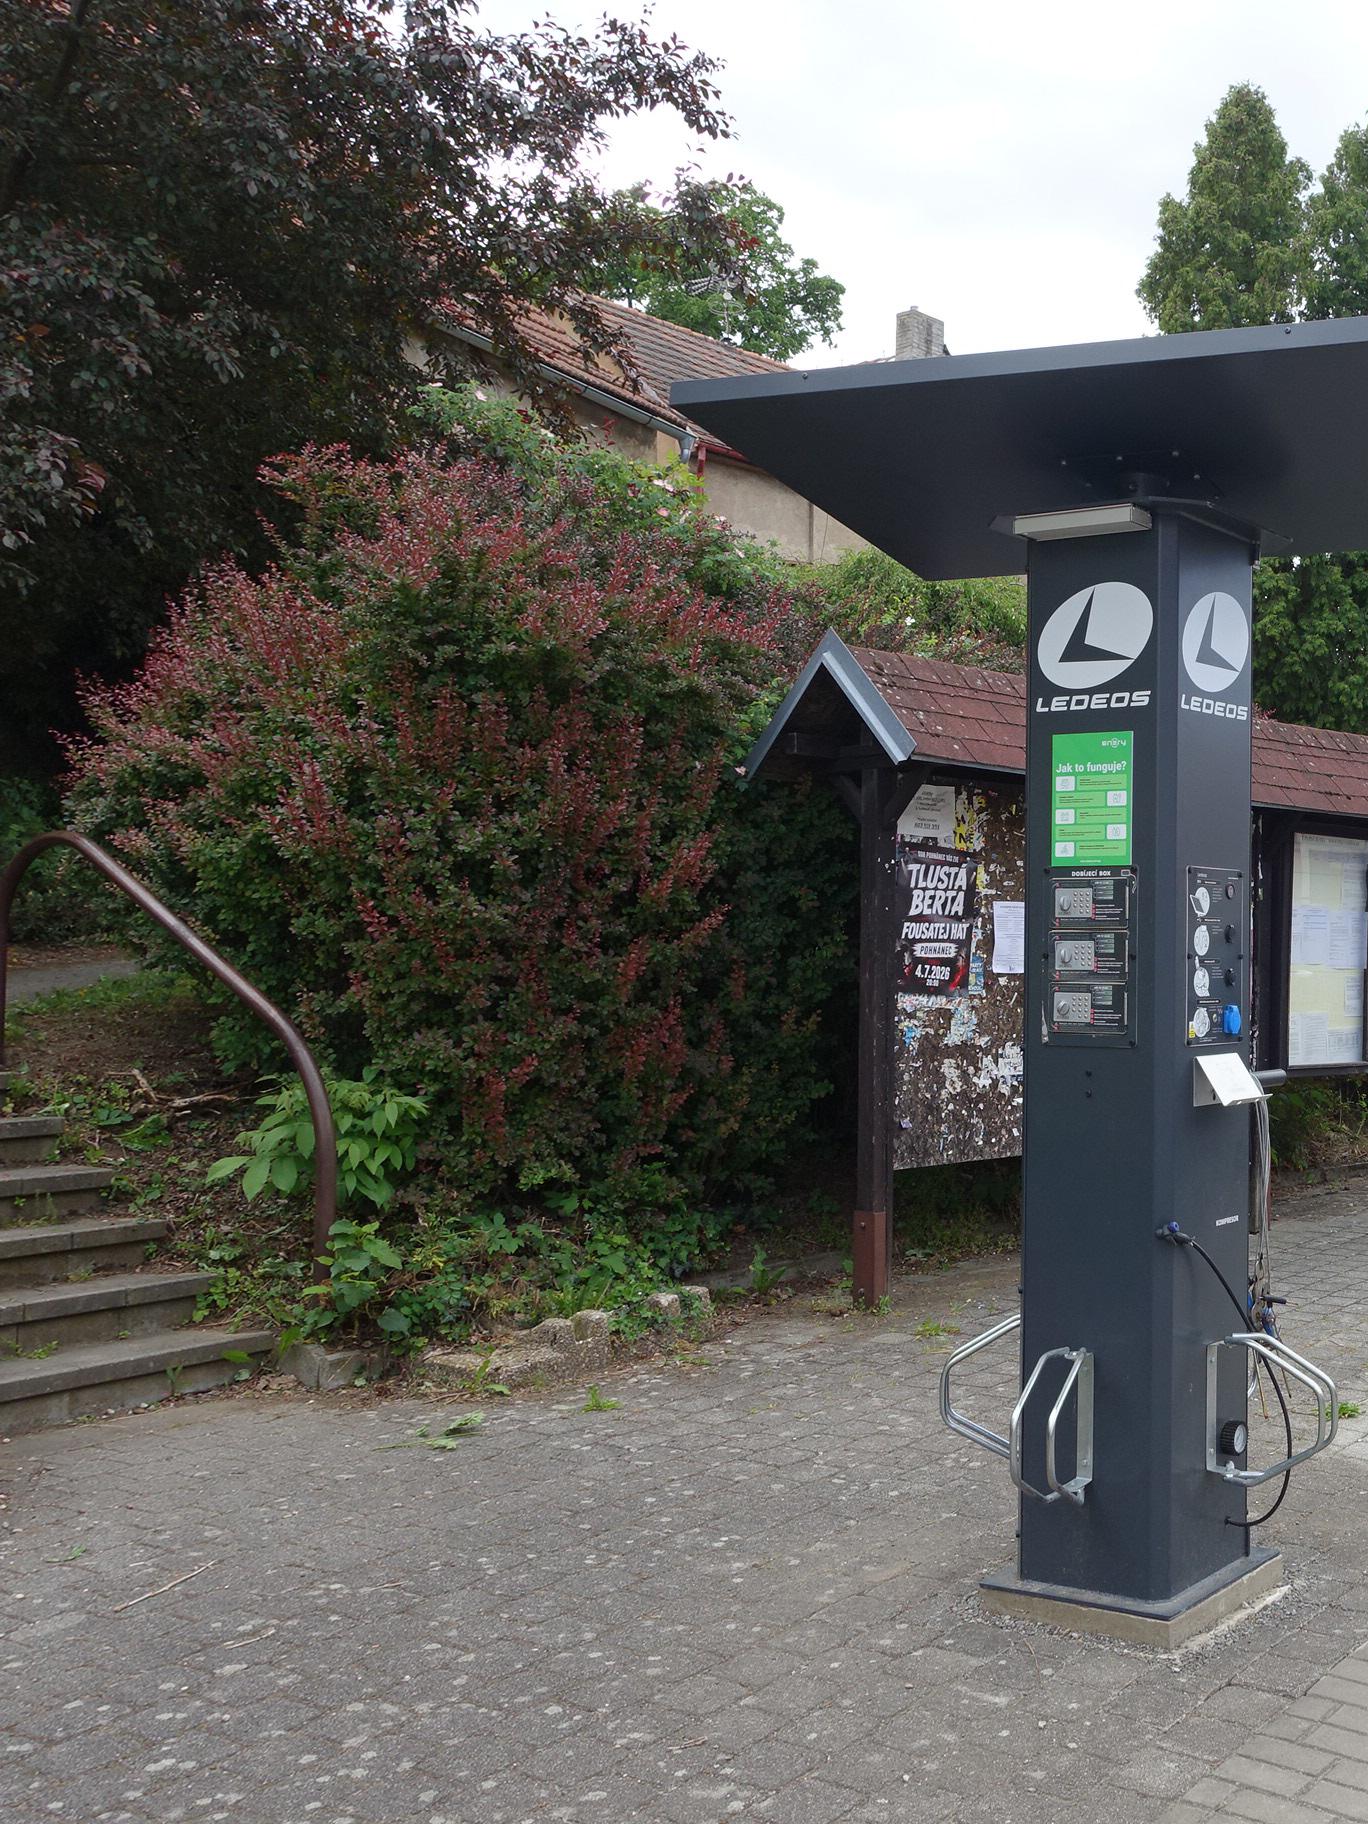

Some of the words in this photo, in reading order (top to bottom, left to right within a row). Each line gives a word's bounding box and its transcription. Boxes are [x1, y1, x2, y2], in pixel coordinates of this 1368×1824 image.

[1036, 690, 1151, 712] LEDEOS
[1181, 694, 1248, 721] LEDEOS
[1056, 763, 1072, 773] Jak
[1075, 764, 1084, 772] to
[1087, 761, 1127, 773] funguje?
[907, 862, 967, 890] TLUSTÁ
[907, 889, 965, 916] BERTA
[901, 922, 950, 940] FOUSATEJ
[920, 944, 952, 956] POHNÁNEC
[915, 964, 951, 980] 4.7.2026
